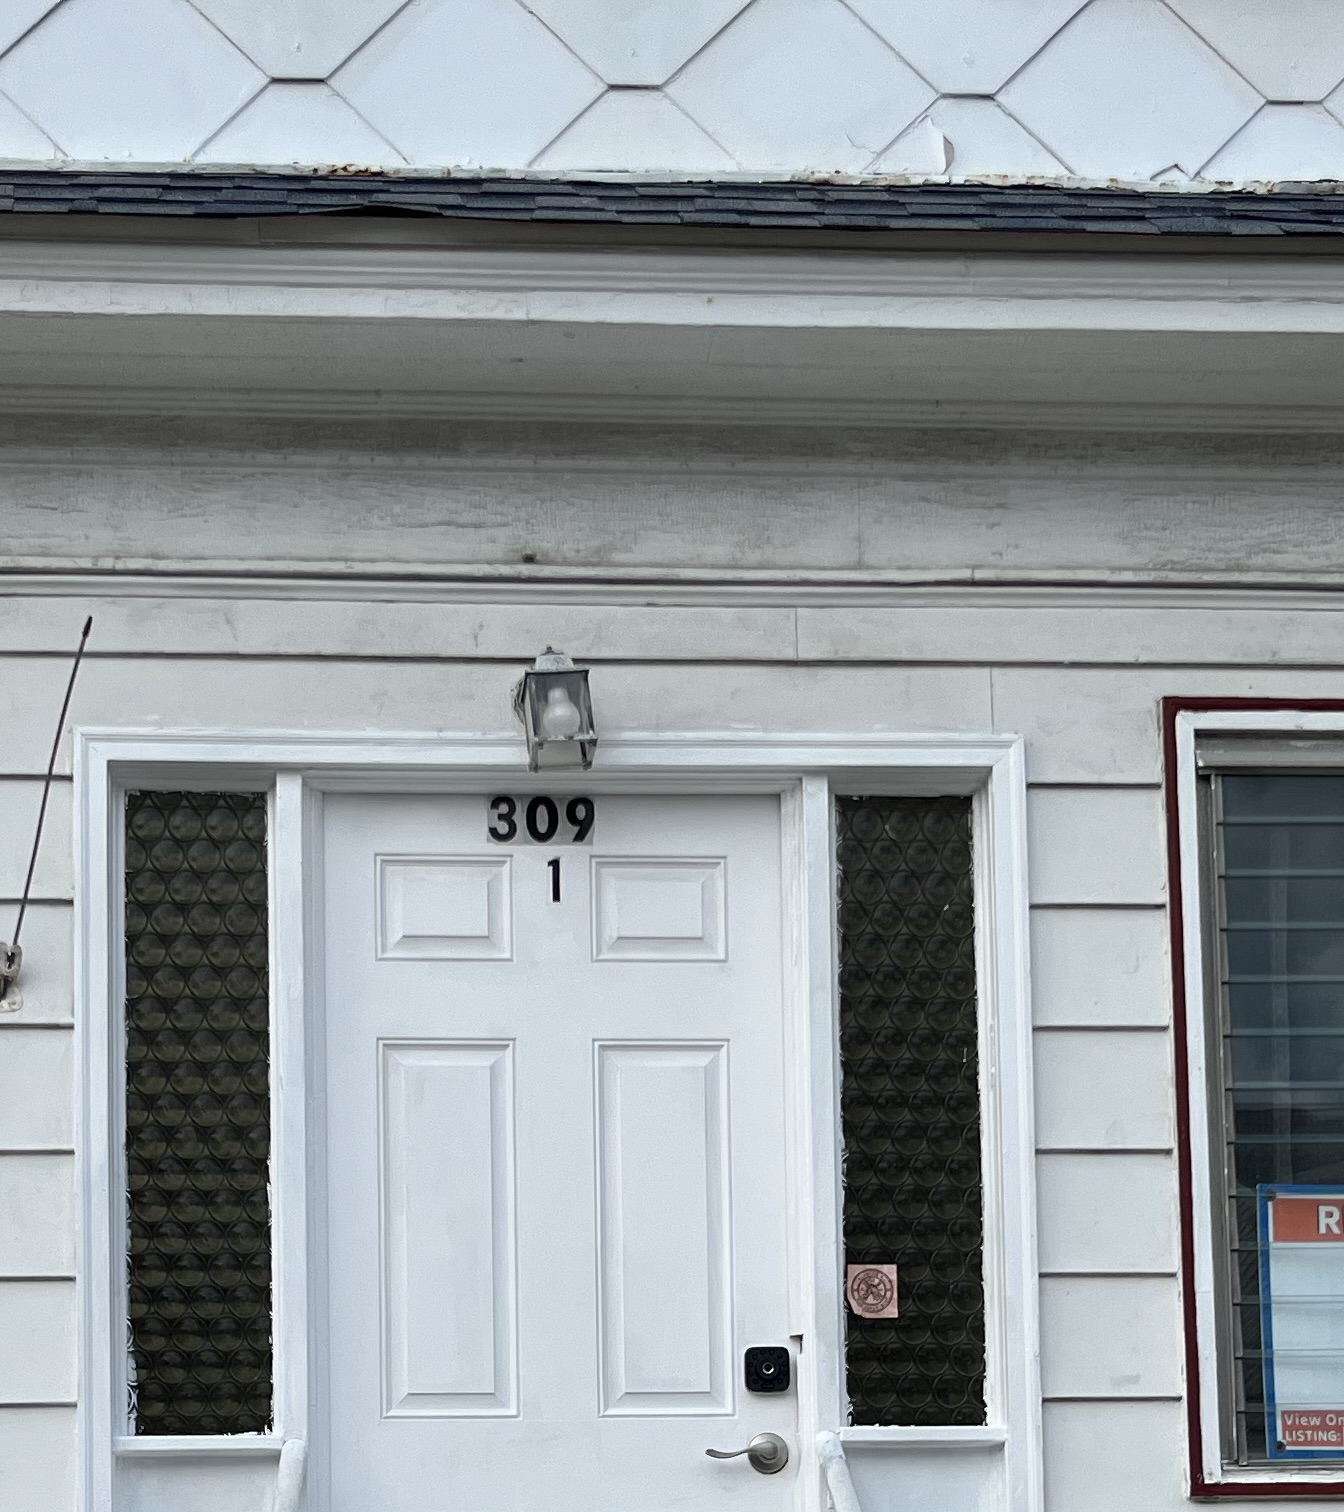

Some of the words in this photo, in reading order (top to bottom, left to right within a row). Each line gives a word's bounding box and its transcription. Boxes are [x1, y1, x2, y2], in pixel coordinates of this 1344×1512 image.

[488, 796, 595, 843] 309
[547, 857, 561, 903] 1
[1284, 1413, 1321, 1426] View
[1285, 1430, 1341, 1442] LISTING:
